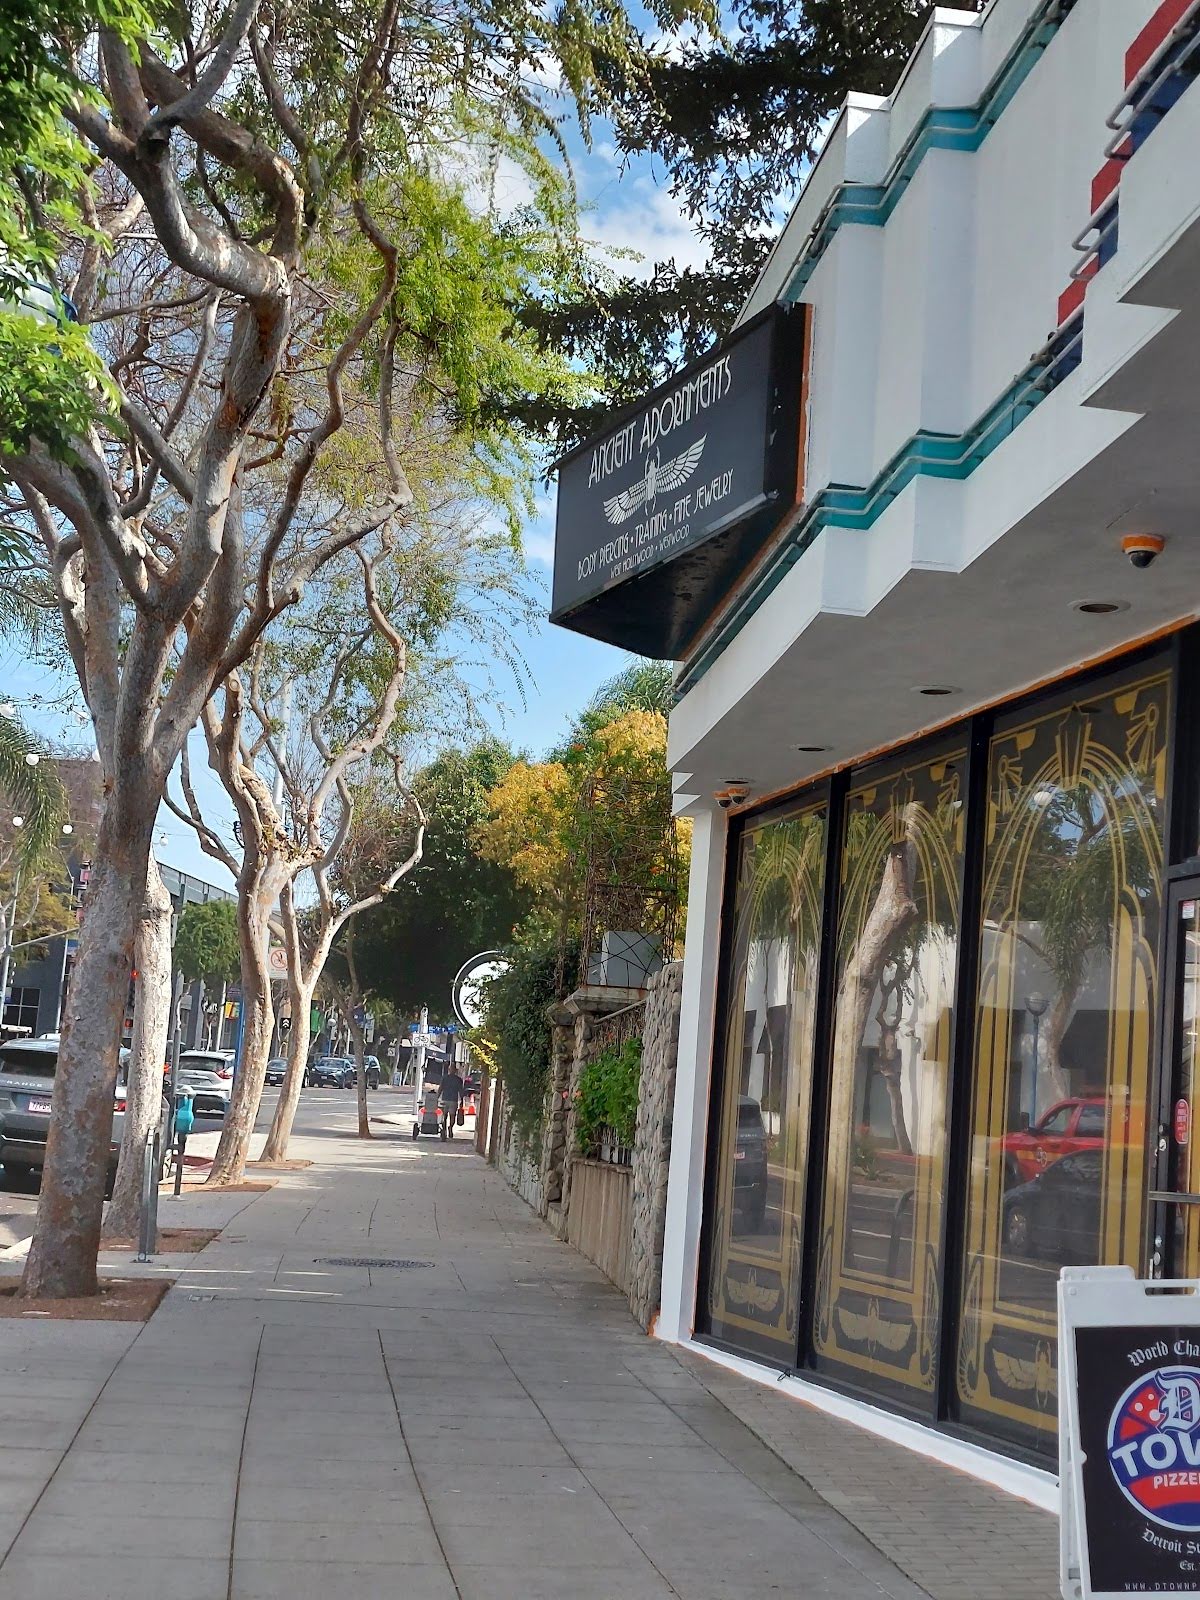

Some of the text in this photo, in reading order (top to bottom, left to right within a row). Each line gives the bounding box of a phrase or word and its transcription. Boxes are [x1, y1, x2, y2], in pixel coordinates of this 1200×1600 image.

[588, 354, 732, 489] ANCIENT ADORNMENTS
[577, 468, 734, 582] BODY PIERCING TRAINING FINE JEWELRY
[610, 562, 622, 579] WEST
[622, 544, 654, 573] HOLLYWOOD
[1127, 1340, 1169, 1367] World
[1153, 1471, 1200, 1489] PIZZE
[1142, 1527, 1182, 1553] Detroit
